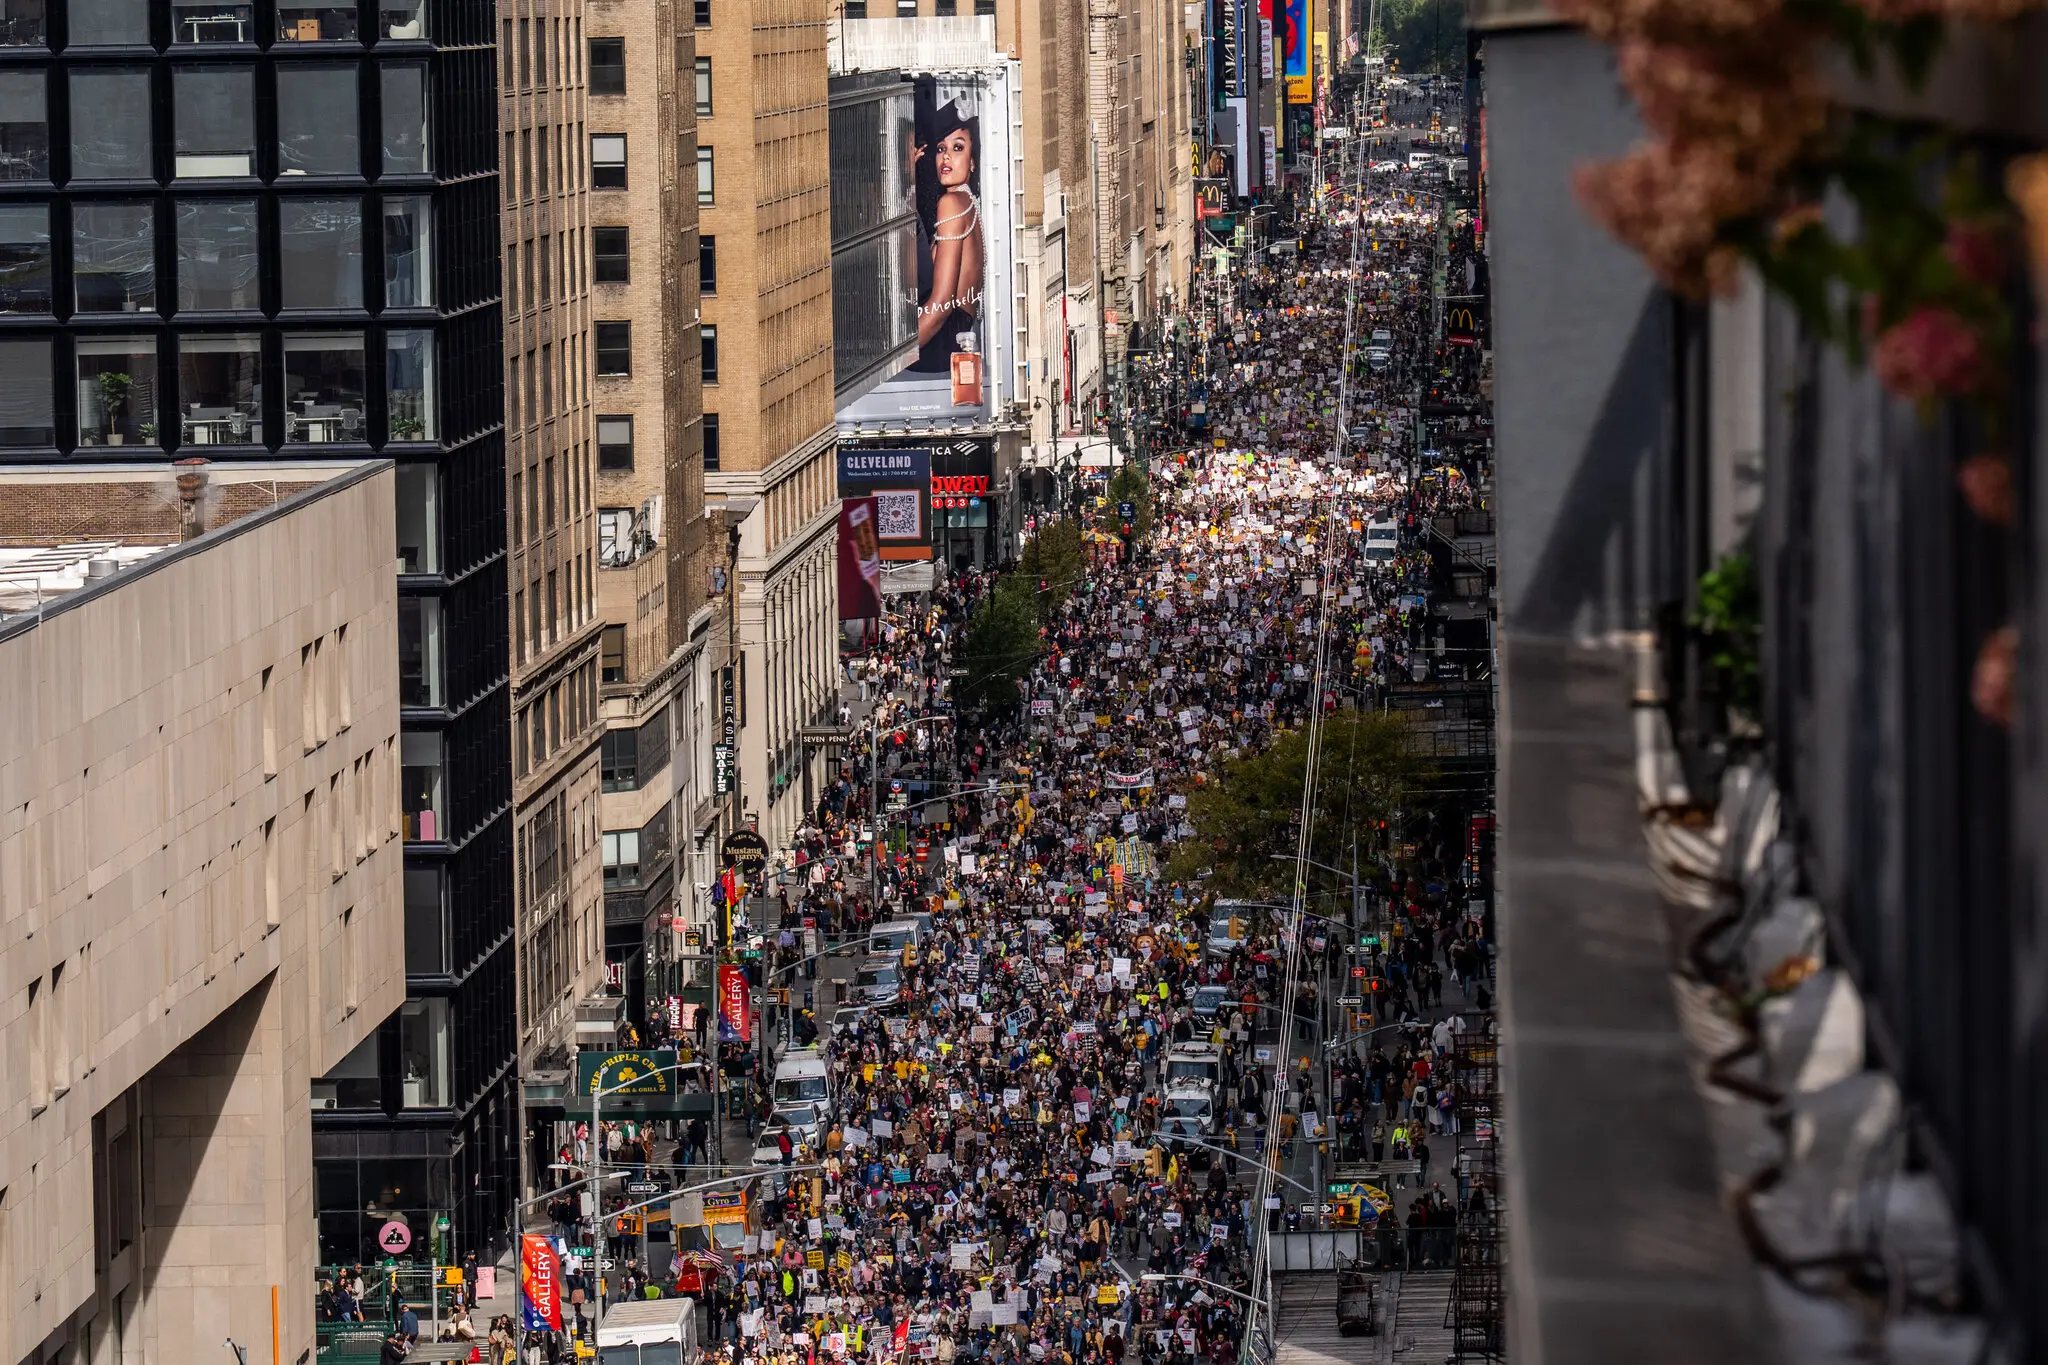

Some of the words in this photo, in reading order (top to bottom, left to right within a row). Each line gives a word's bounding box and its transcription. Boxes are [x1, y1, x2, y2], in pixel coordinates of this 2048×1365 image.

[846, 456, 912, 469] CLEVELAND
[902, 582, 930, 590] STATION
[1032, 707, 1052, 715] ICE
[724, 695, 735, 745] ERASE
[803, 735, 825, 743] SEVEN
[828, 735, 848, 743] PENN
[715, 751, 727, 792] NAILS
[725, 846, 762, 856] Mustang
[735, 852, 765, 862] Harry's
[731, 977, 742, 1031] GALLERY
[1009, 1011, 1020, 1020] NO
[1019, 1007, 1030, 1016] TO
[600, 1054, 640, 1070] TRIPLE
[707, 1197, 730, 1206] Gyro
[538, 1251, 551, 1319] GALLERY
